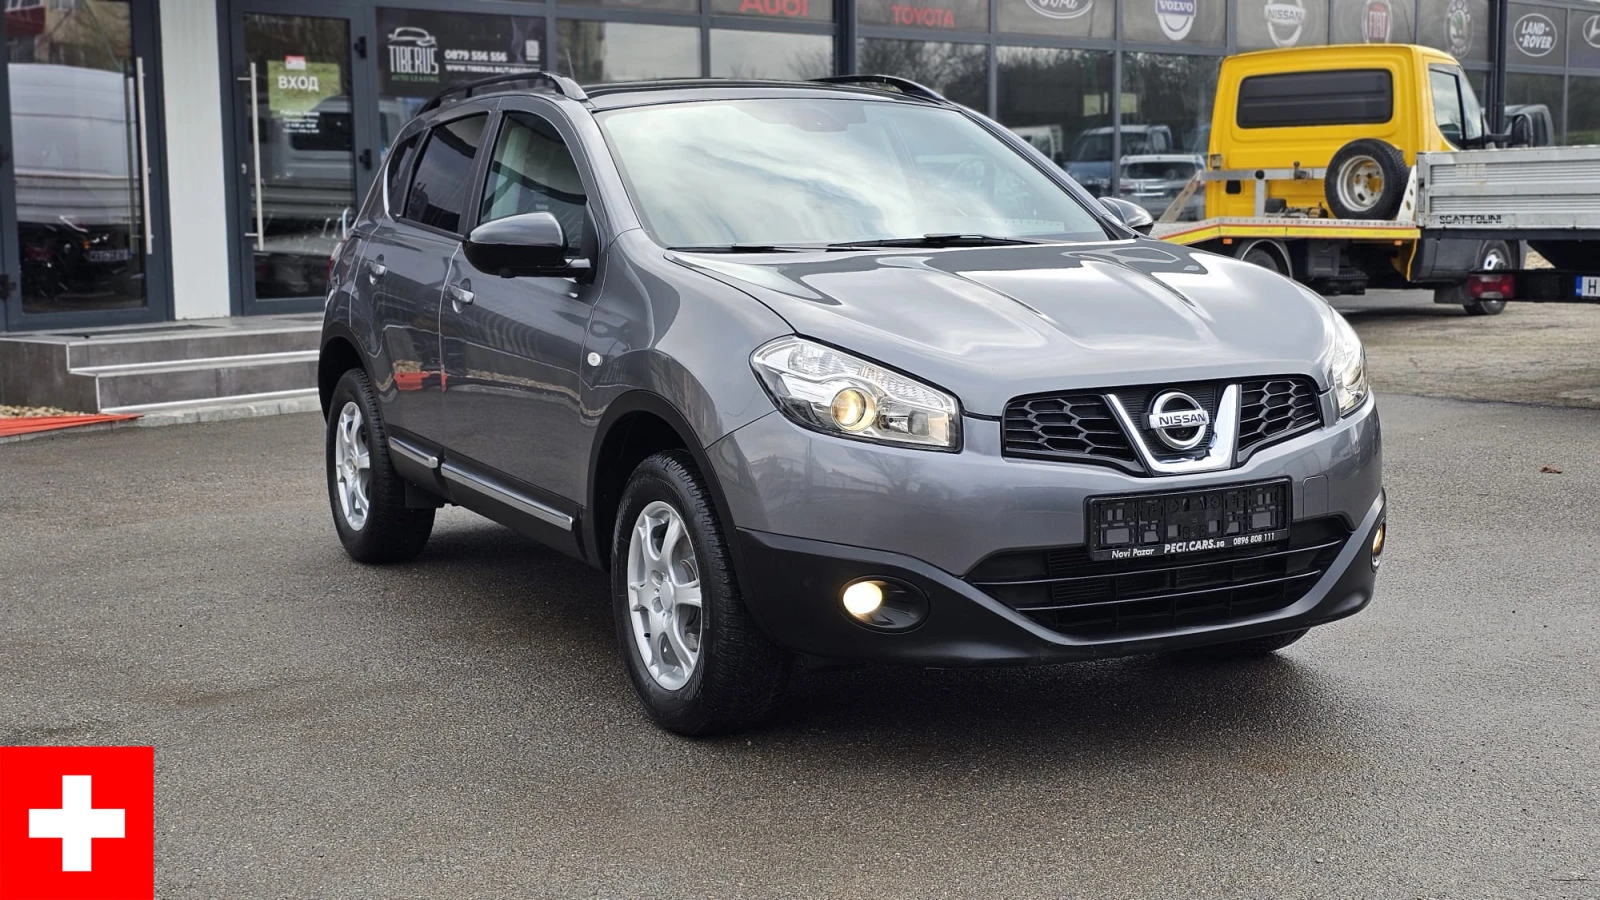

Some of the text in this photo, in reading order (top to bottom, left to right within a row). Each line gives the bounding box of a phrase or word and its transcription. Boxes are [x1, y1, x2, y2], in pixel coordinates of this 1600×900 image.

[1159, 1, 1193, 13] VOLVO
[892, 5, 956, 28] TOYOTA
[1267, 8, 1303, 21] NISSAN
[1368, 11, 1387, 39] FIAT
[387, 45, 439, 75] TIBERUS
[444, 49, 469, 61] 0879
[278, 75, 319, 91] ВХОД
[1159, 413, 1206, 426] NISSAN
[1233, 532, 1275, 546] 0896 808 111
[1111, 548, 1155, 559] Novi Pazar
